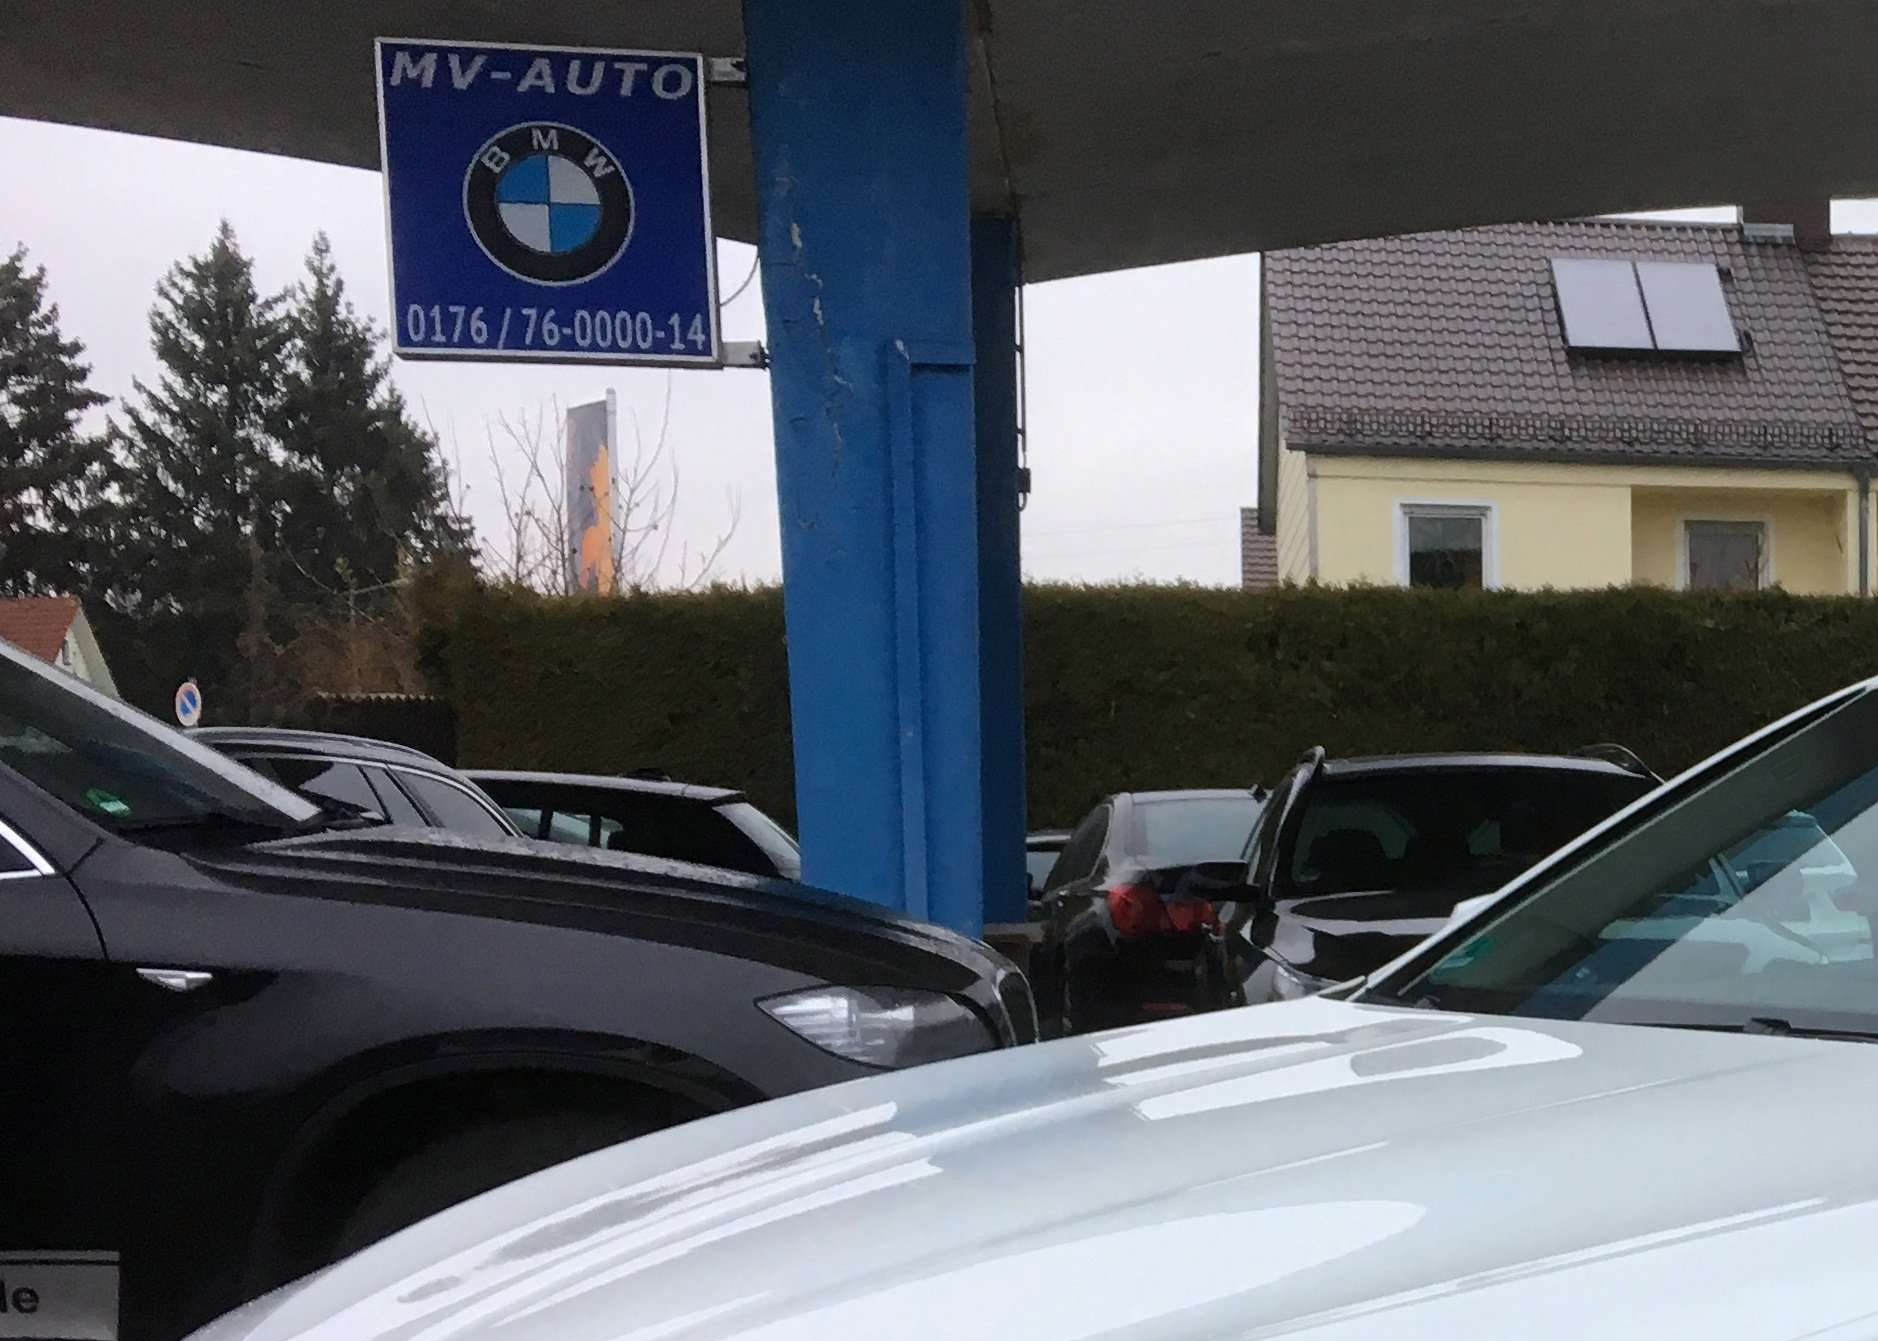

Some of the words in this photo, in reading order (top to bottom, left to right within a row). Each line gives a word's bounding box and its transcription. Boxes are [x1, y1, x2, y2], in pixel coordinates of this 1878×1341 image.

[389, 51, 693, 100] MV-AUTO
[480, 127, 615, 178] BMW
[407, 304, 488, 344] 0176
[522, 306, 706, 351] 76-0000-14
